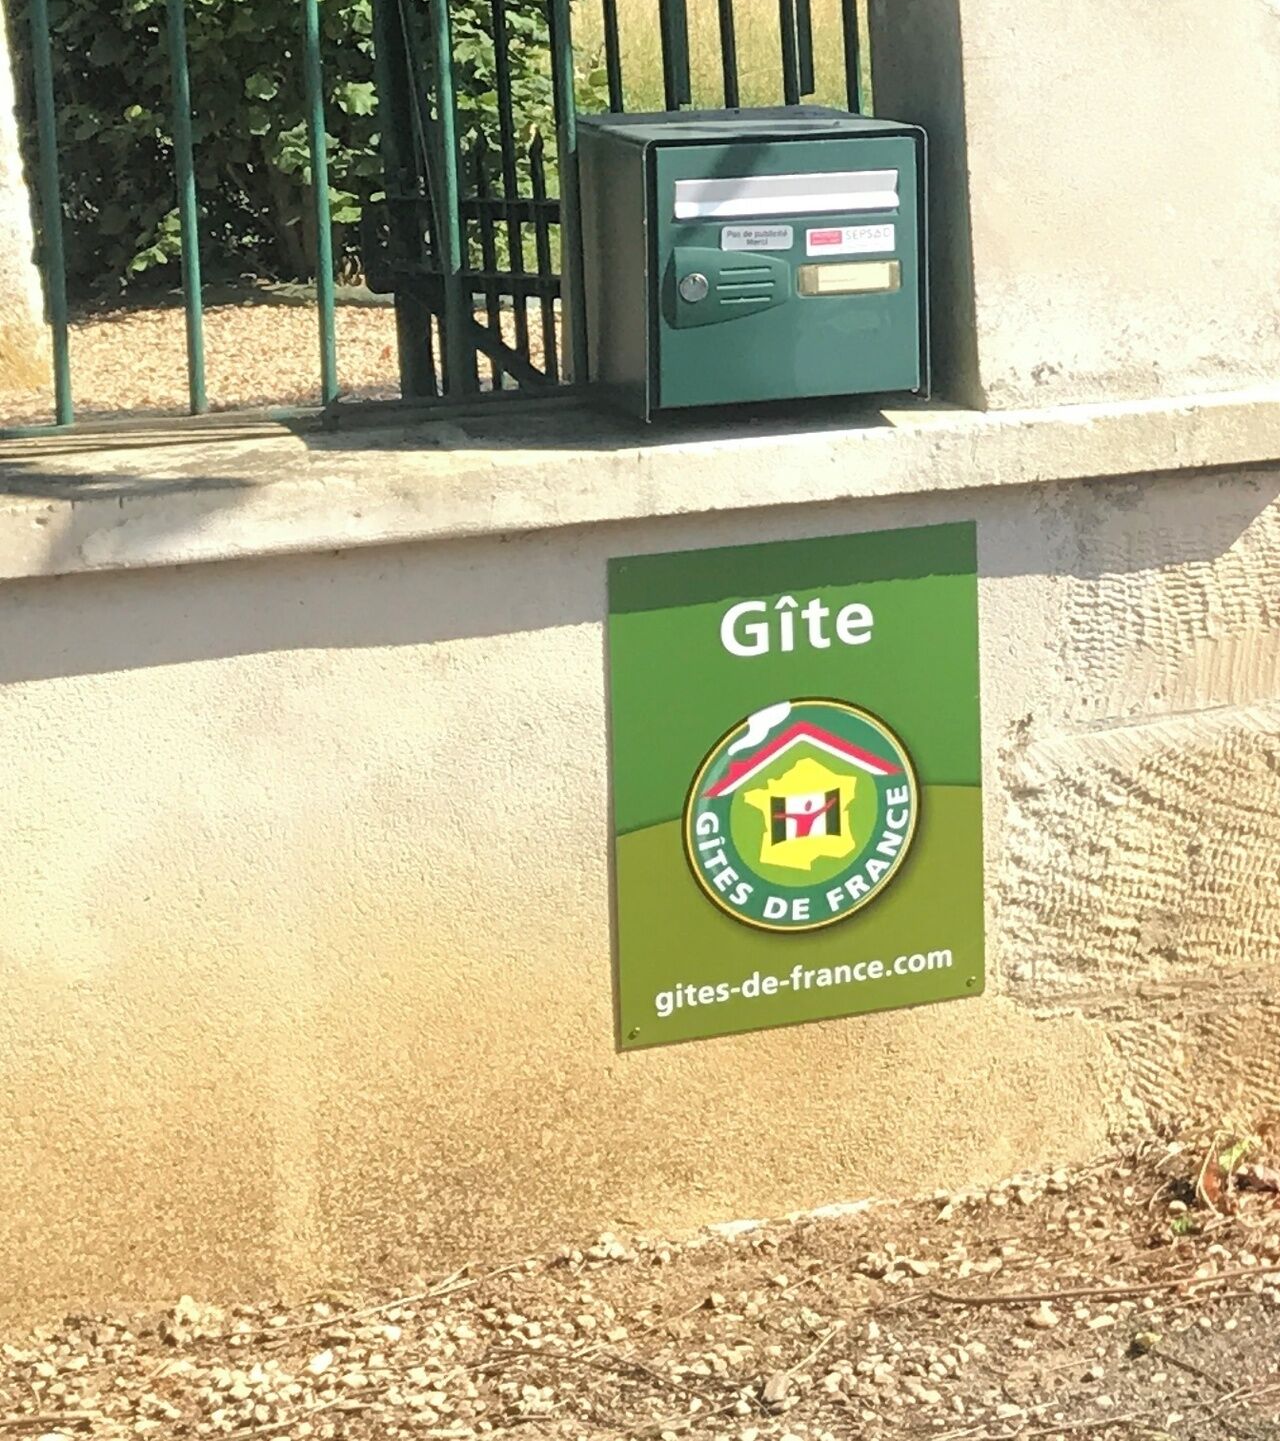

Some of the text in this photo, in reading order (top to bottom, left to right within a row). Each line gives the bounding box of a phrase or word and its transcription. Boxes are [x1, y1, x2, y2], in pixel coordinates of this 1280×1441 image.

[743, 230, 753, 238] de
[719, 595, 875, 657] Gîte
[696, 784, 909, 921] GÎTES DE FRANCE
[654, 947, 953, 1018] gites-de-france.com
